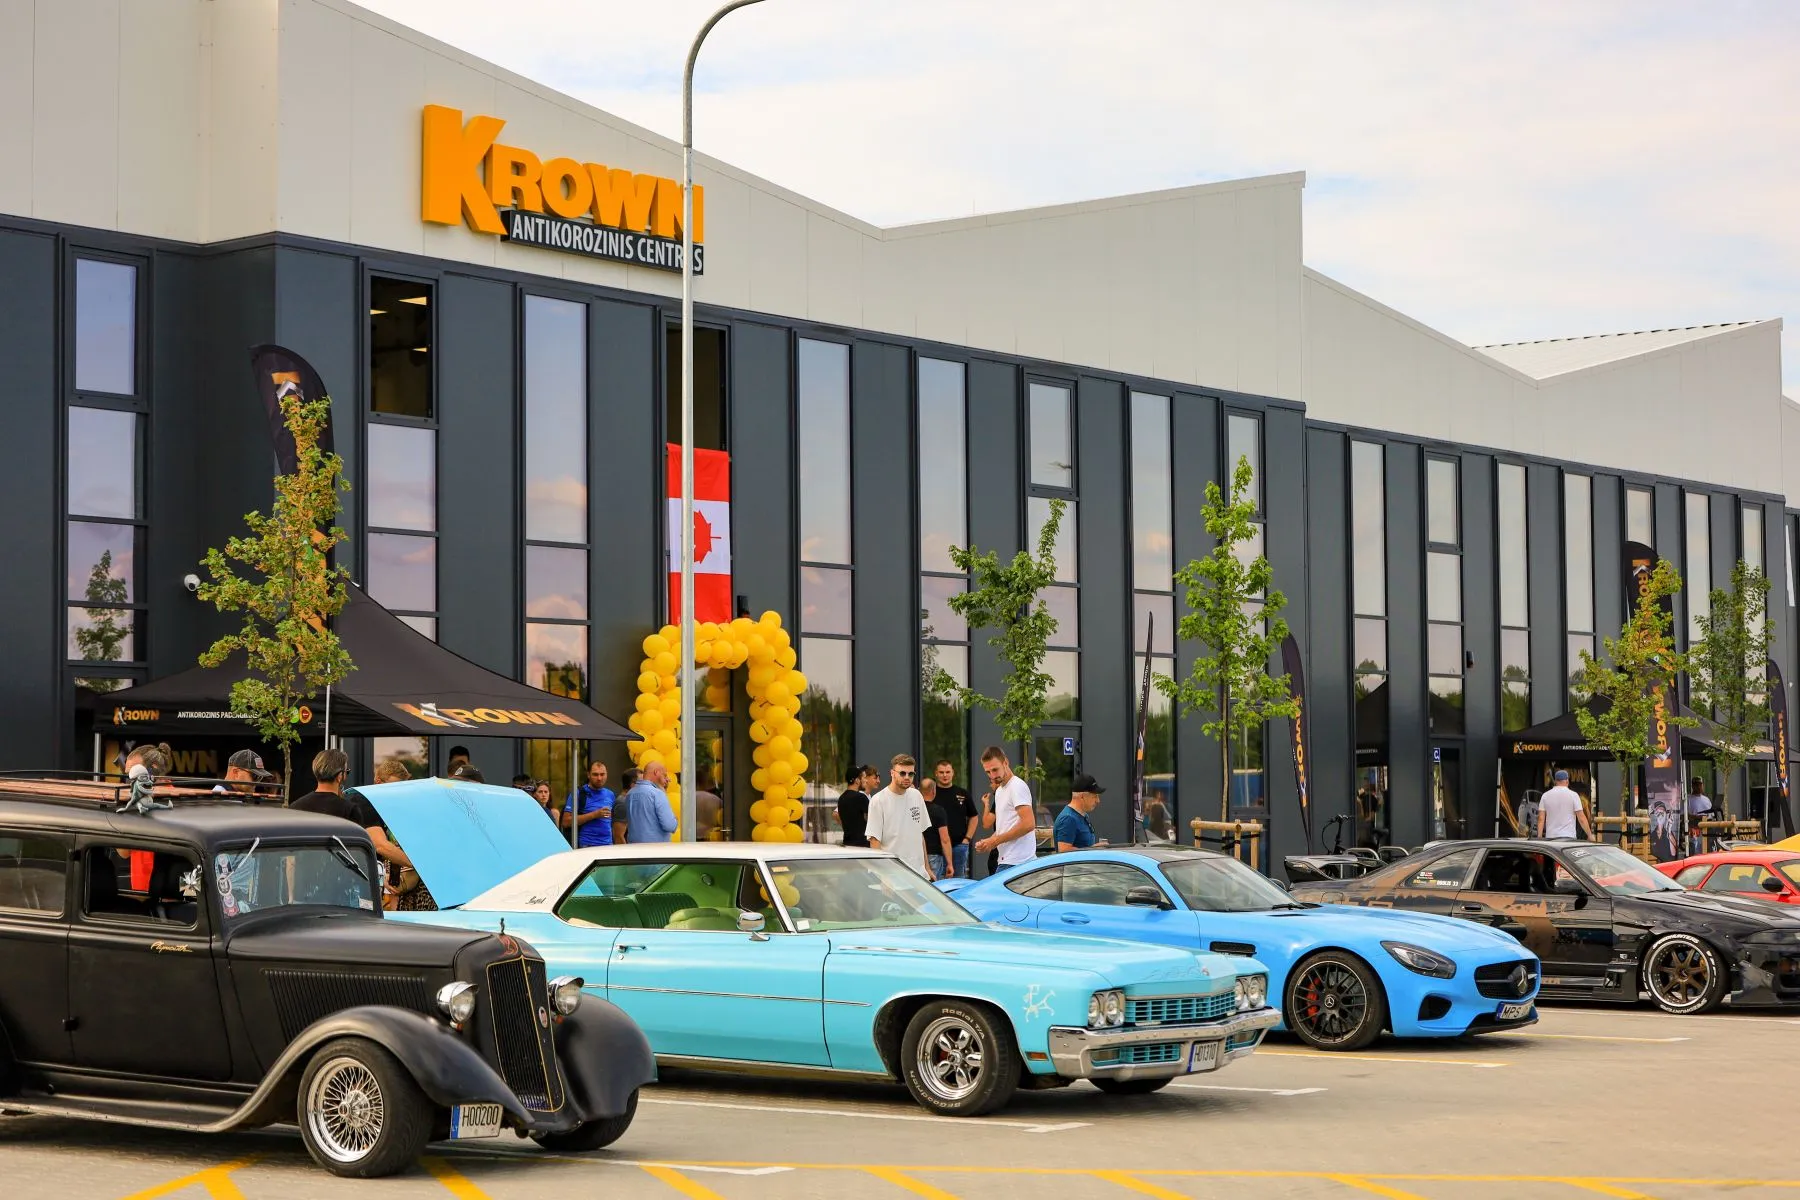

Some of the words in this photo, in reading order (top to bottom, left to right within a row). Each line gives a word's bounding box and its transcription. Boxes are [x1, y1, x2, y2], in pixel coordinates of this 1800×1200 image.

[422, 104, 704, 243] KROWN
[512, 214, 634, 259] ANTIKOROZINIS
[637, 239, 702, 272] CENTRS
[113, 706, 160, 726] KROWN
[177, 711, 220, 719] ANTIKOROZINIS
[392, 703, 582, 729] KROWN
[1513, 742, 1550, 754] KROWN
[150, 940, 193, 953] Plymouth
[942, 1008, 974, 1024] Radial
